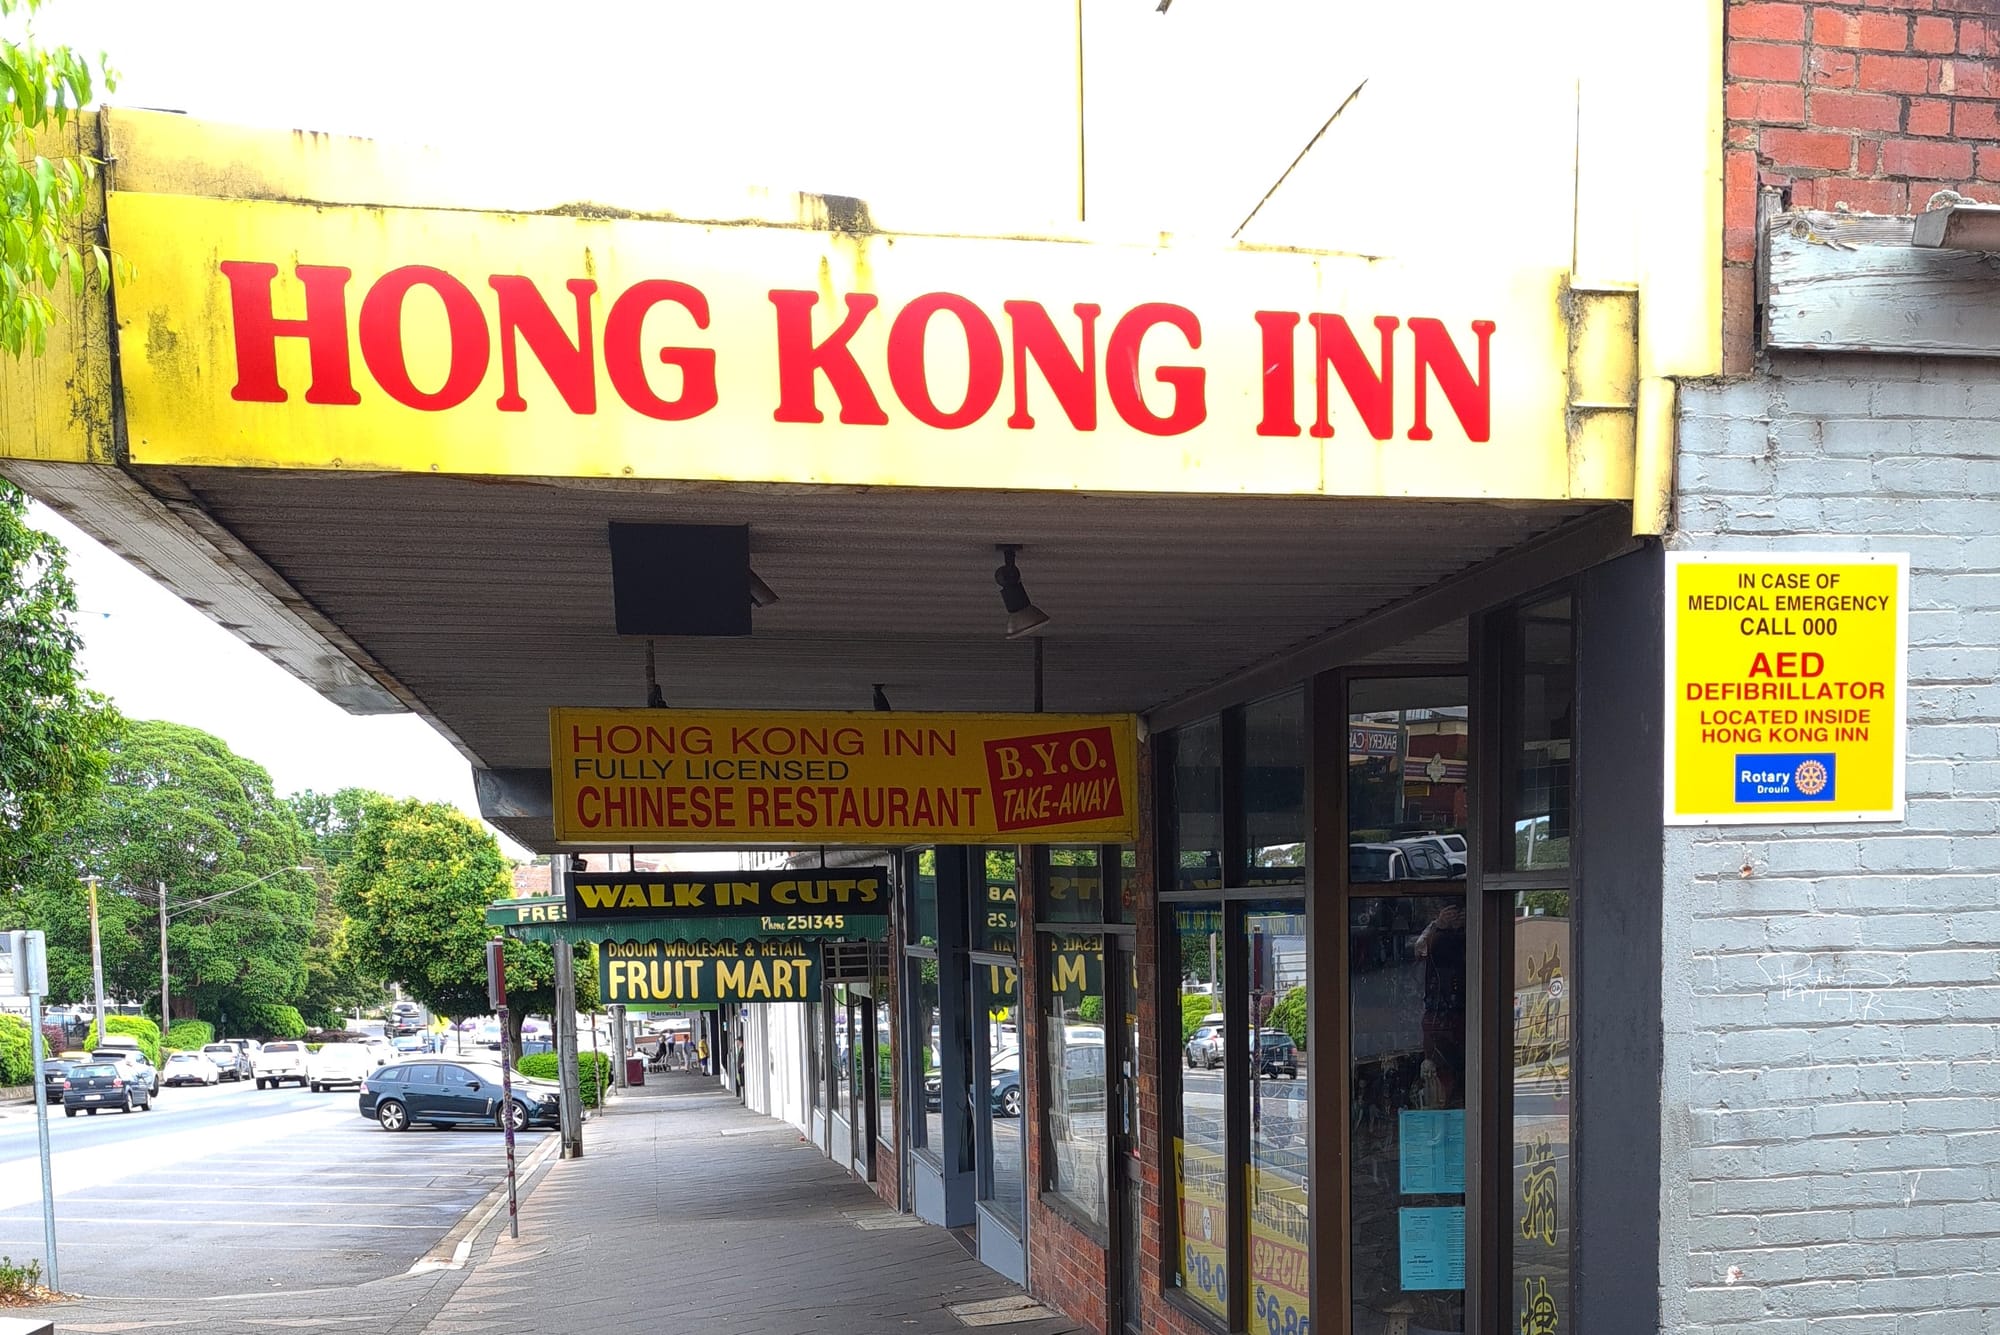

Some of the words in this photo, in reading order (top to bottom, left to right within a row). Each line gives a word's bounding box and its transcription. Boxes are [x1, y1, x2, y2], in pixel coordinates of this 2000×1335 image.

[220, 260, 718, 421] HONG
[768, 291, 1207, 436] KONG
[1255, 311, 1496, 442] INN
[1738, 573, 1755, 589] IN
[1761, 573, 1810, 589] CASE
[1816, 573, 1840, 589] OF
[1688, 595, 1769, 611] MEDICAL
[1775, 596, 1889, 611] EMERGENCY
[1740, 617, 1796, 636] CALL
[1802, 618, 1838, 636] 000
[1748, 652, 1825, 678] AED
[1686, 682, 1885, 701] DEFIBRILLATOR
[1701, 710, 1798, 725] LOCATED
[1804, 709, 1870, 724] INSIDE
[572, 725, 713, 754] HONG
[731, 727, 865, 756] KONG
[883, 729, 956, 756] INN
[1702, 728, 1762, 743] HONG
[1769, 727, 1829, 742] KONG
[1835, 727, 1869, 741] INN
[995, 737, 1107, 781] B.Y.O.
[574, 758, 674, 780] FULLY
[686, 759, 849, 781] LICENSED
[1741, 770, 1790, 784] Rotary
[1757, 785, 1790, 793] Drouin
[577, 785, 735, 828] CHINESE
[747, 786, 981, 828] RESTAURANT
[1003, 777, 1115, 823] TAKE-AWAY
[576, 882, 706, 908] WALK
[714, 881, 760, 906] IN
[771, 878, 879, 905] CUTS
[787, 915, 845, 930] 251345
[608, 942, 657, 957] DROUIN
[664, 942, 739, 957] WHOLESALE
[745, 943, 754, 956] &
[761, 942, 806, 957] RETAIL
[608, 960, 703, 1000] FRUIT
[716, 959, 813, 999] MART
